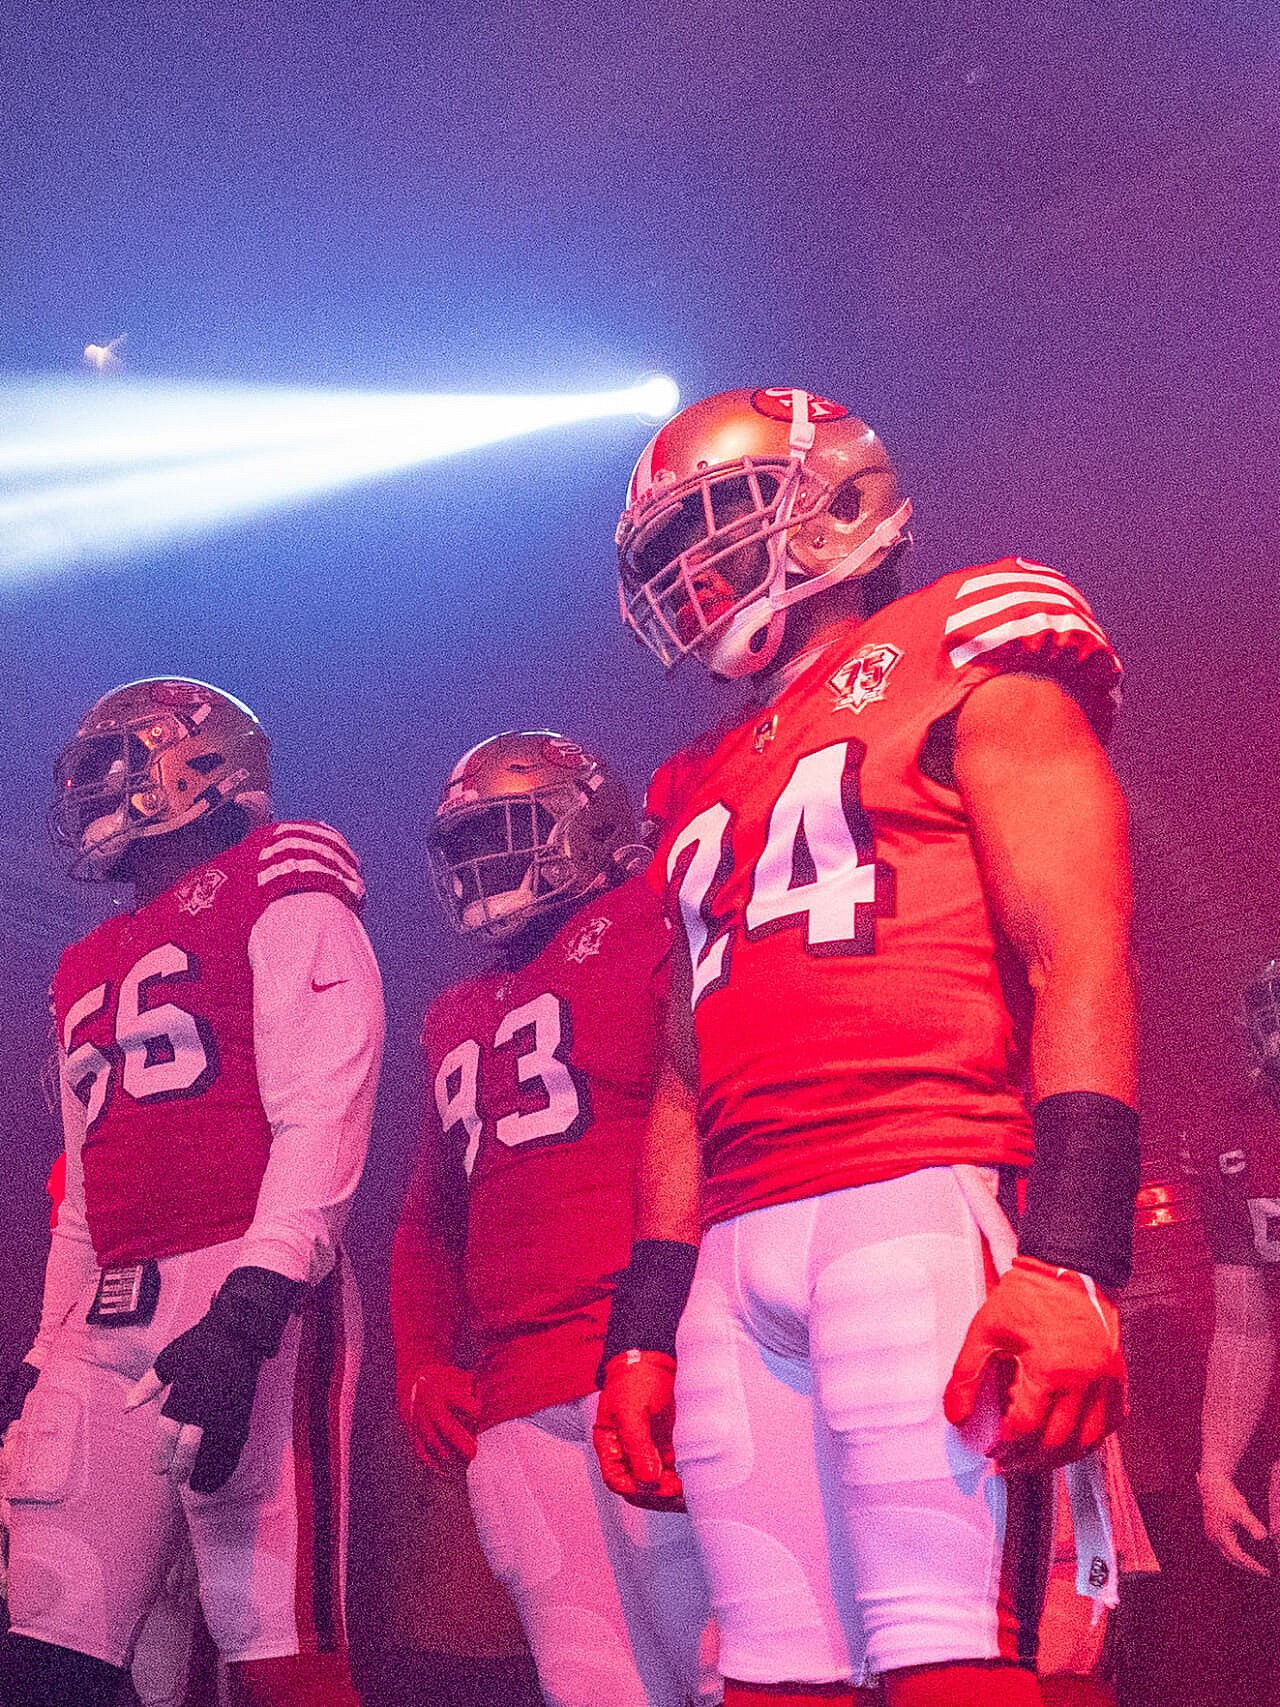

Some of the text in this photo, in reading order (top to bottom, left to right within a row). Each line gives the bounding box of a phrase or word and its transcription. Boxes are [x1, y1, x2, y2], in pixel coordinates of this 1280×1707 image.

[665, 738, 892, 1013] 24
[63, 940, 214, 1130] 56
[434, 992, 588, 1183] 93
